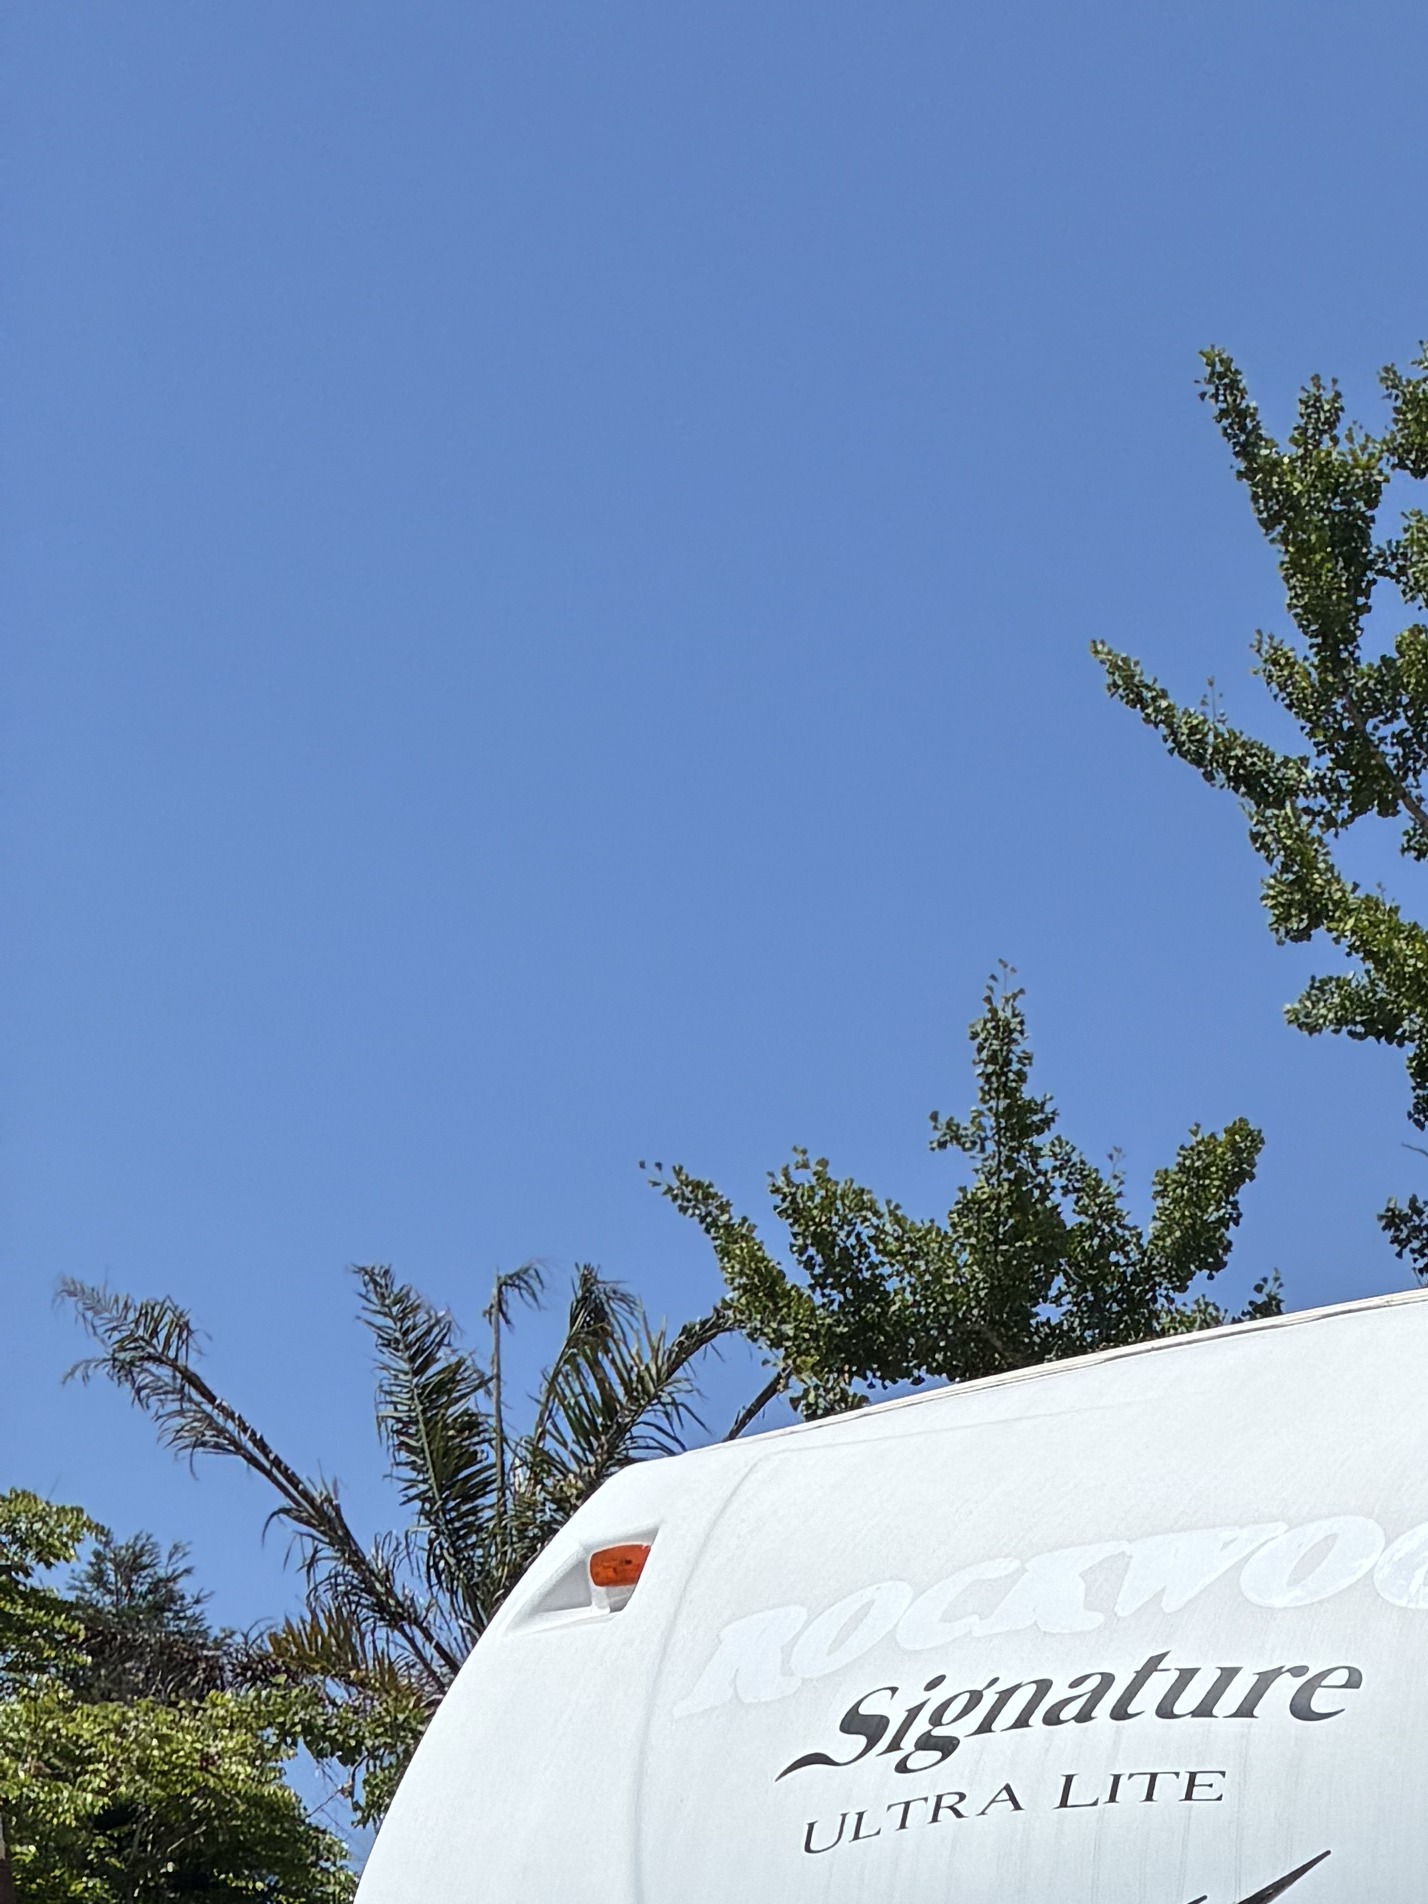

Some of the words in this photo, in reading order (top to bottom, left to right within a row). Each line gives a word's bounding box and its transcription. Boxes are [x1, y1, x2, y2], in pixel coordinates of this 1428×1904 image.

[775, 1650, 1364, 1781] Signature
[803, 1785, 1025, 1855] ULTRA
[1053, 1769, 1226, 1811] LITE
